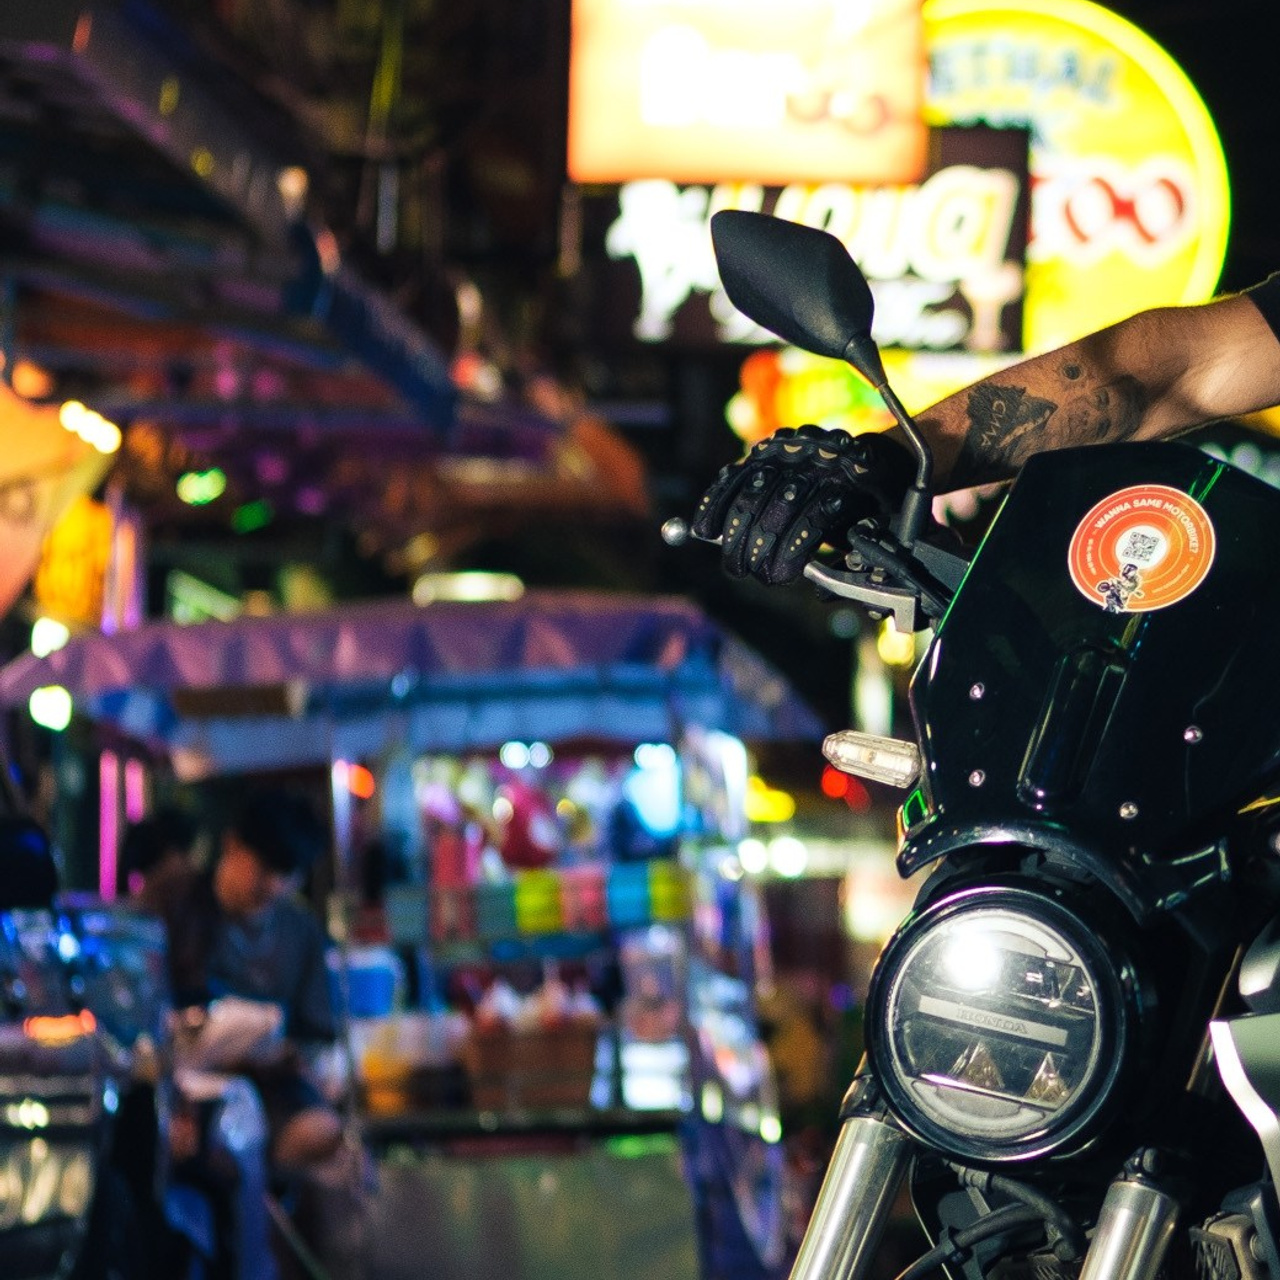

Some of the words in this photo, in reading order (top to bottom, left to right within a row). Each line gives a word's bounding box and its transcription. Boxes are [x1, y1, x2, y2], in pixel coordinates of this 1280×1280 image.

[1094, 502, 1131, 529] WANNA
[1132, 498, 1163, 509] SAME
[1162, 501, 1199, 554] MOTORBIKE?
[956, 1006, 1028, 1034] HONDA
